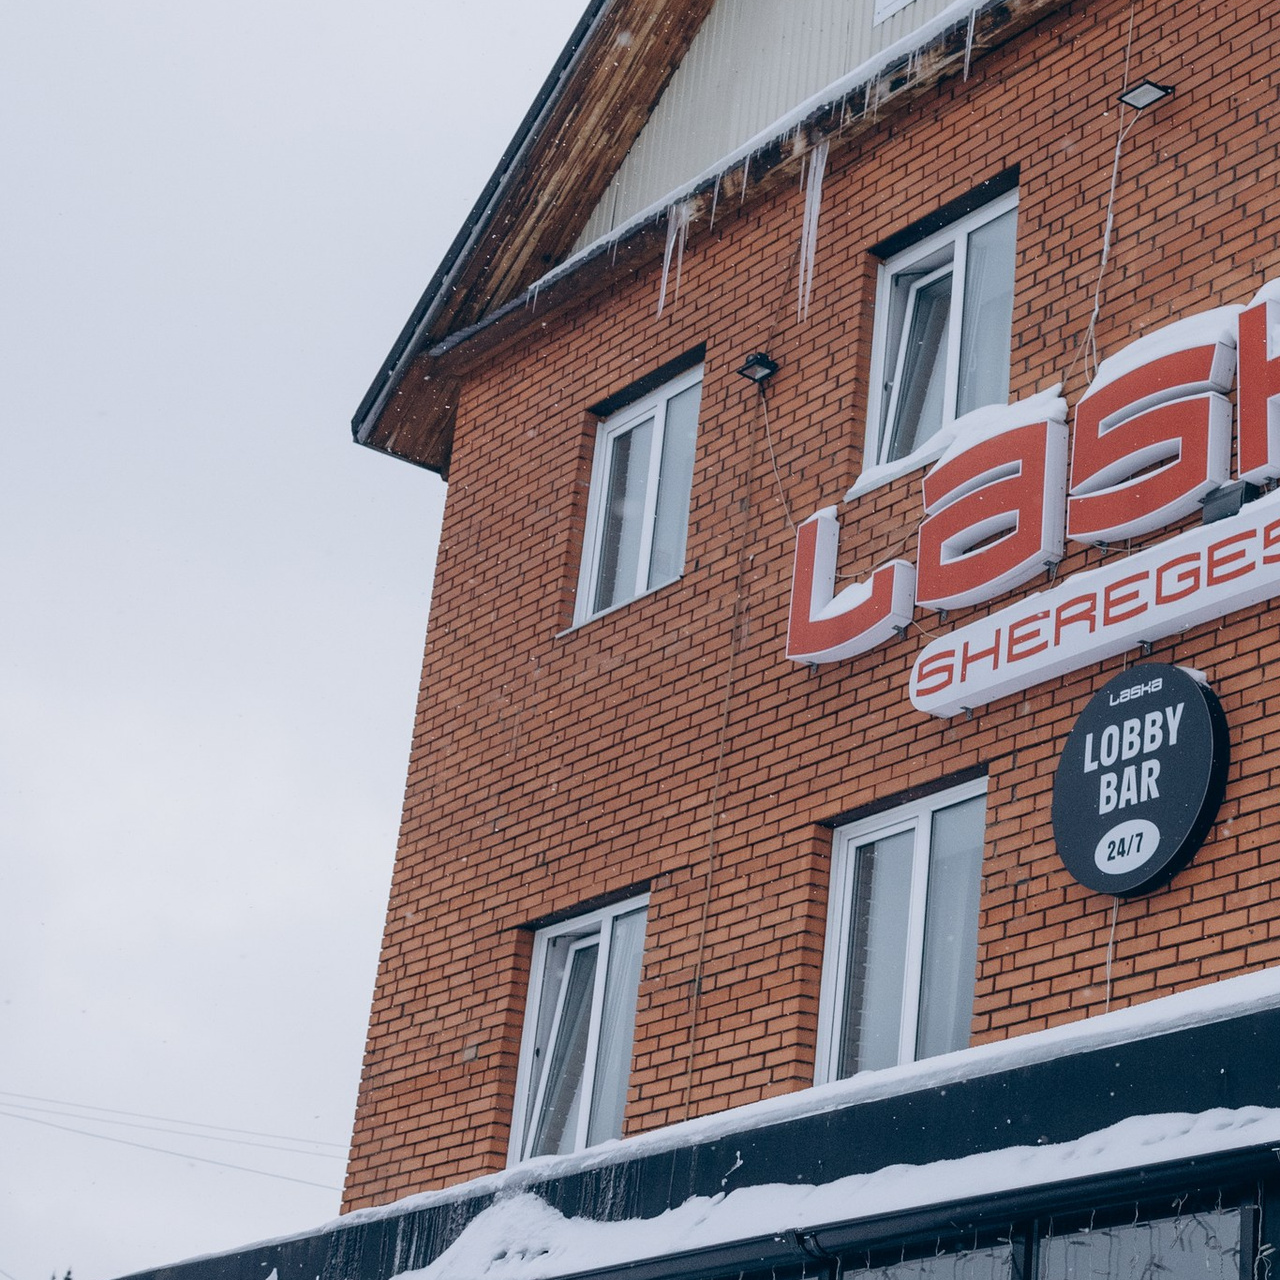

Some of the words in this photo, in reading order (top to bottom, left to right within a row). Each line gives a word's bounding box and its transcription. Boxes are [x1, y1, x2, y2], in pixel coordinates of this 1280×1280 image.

[1083, 702, 1185, 774] LOBBY
[1098, 758, 1160, 816] BAR
[1106, 831, 1144, 862] 24/7
